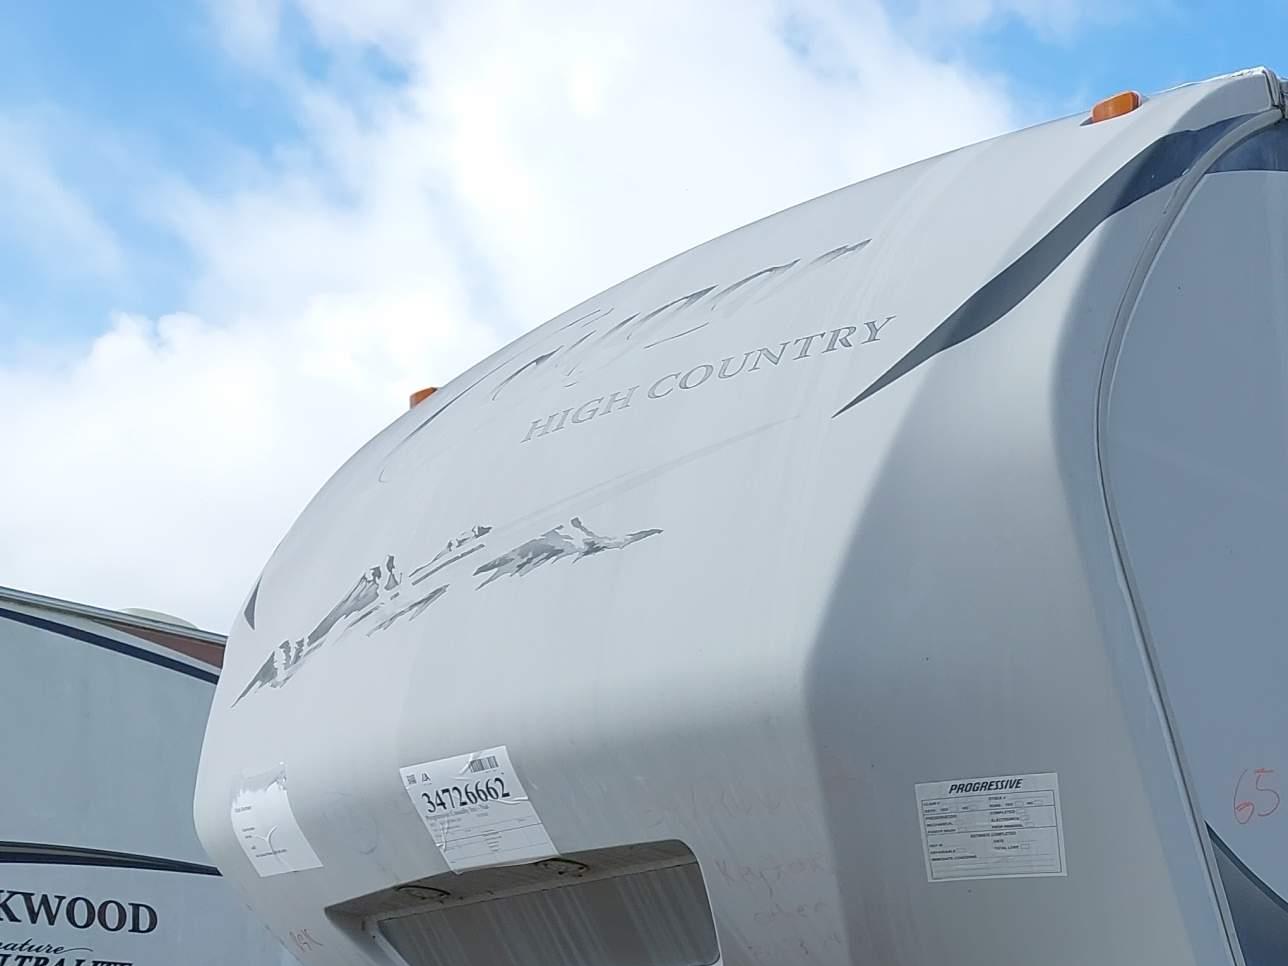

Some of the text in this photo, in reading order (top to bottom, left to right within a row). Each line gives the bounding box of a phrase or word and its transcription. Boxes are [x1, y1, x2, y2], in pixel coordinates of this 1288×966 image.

[520, 315, 897, 443] HIGH COUNTRY
[421, 777, 511, 813] 34726662
[948, 778, 1024, 795] PROGRESSIVE
[1233, 767, 1280, 824] 65
